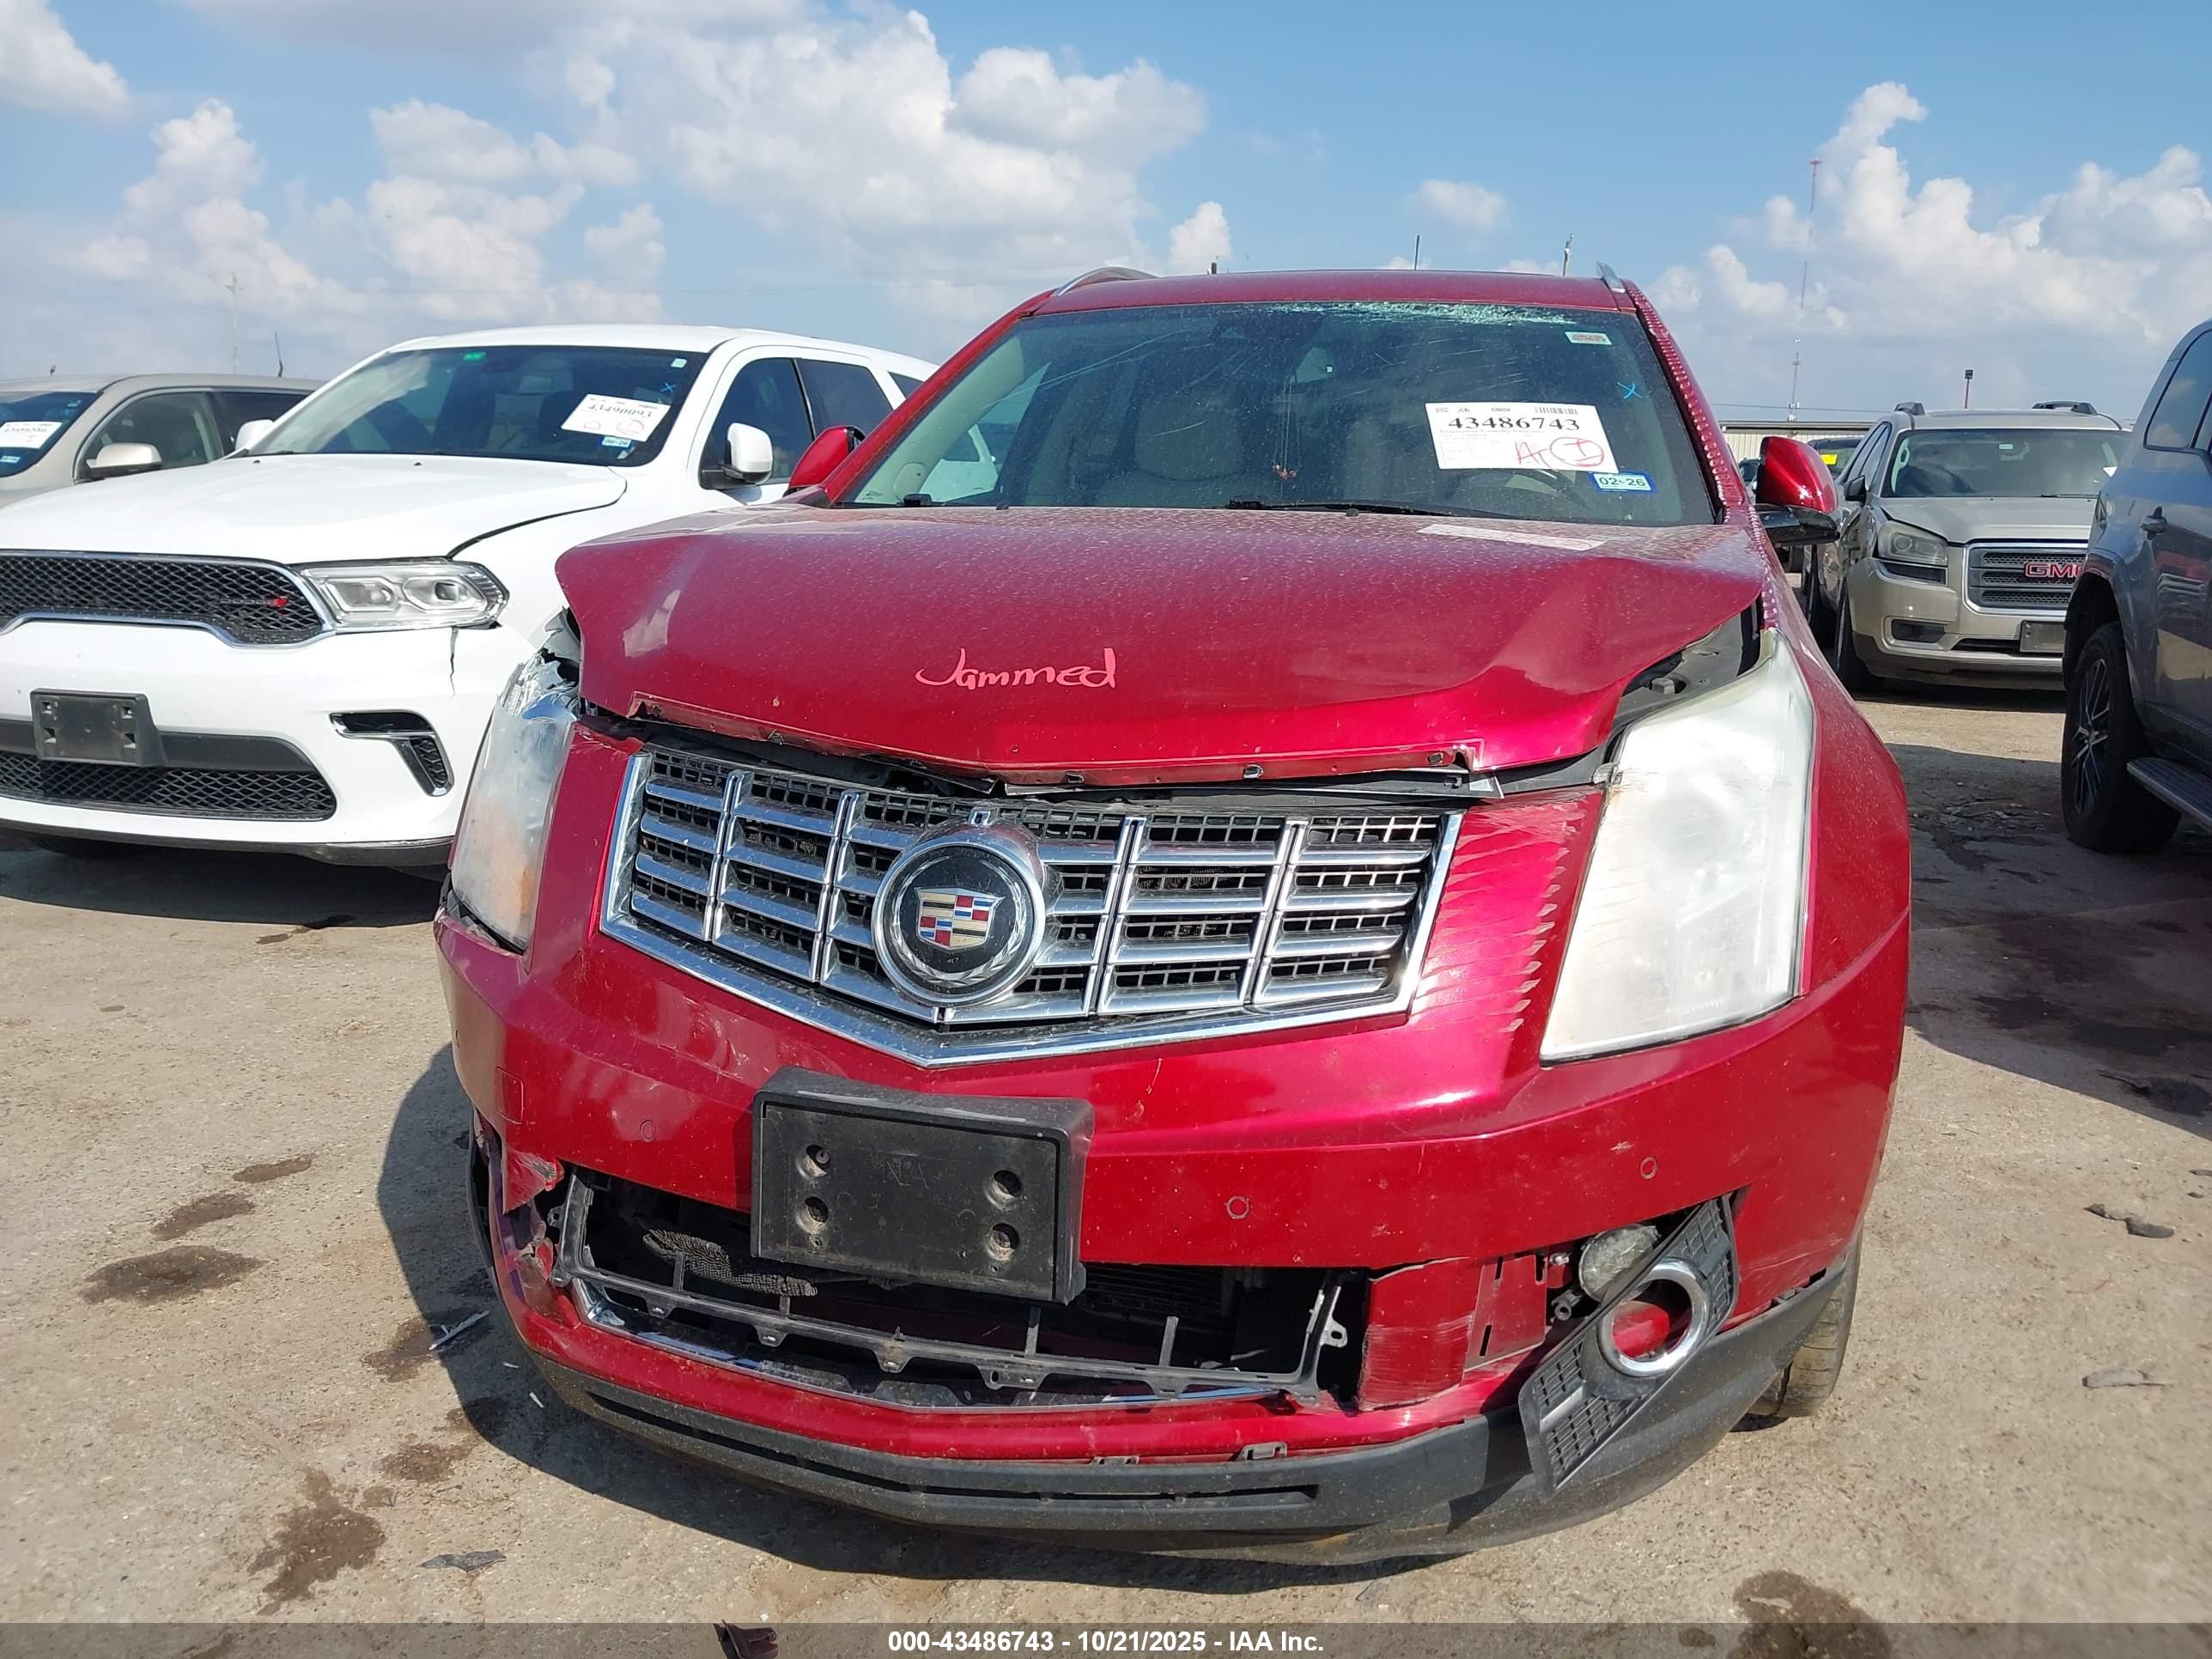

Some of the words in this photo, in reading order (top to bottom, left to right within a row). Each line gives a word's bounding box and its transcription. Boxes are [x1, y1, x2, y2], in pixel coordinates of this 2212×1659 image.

[1449, 416, 1580, 430] 43486743
[1598, 477, 1646, 487] 02-26
[915, 647, 1116, 690] Jammed
